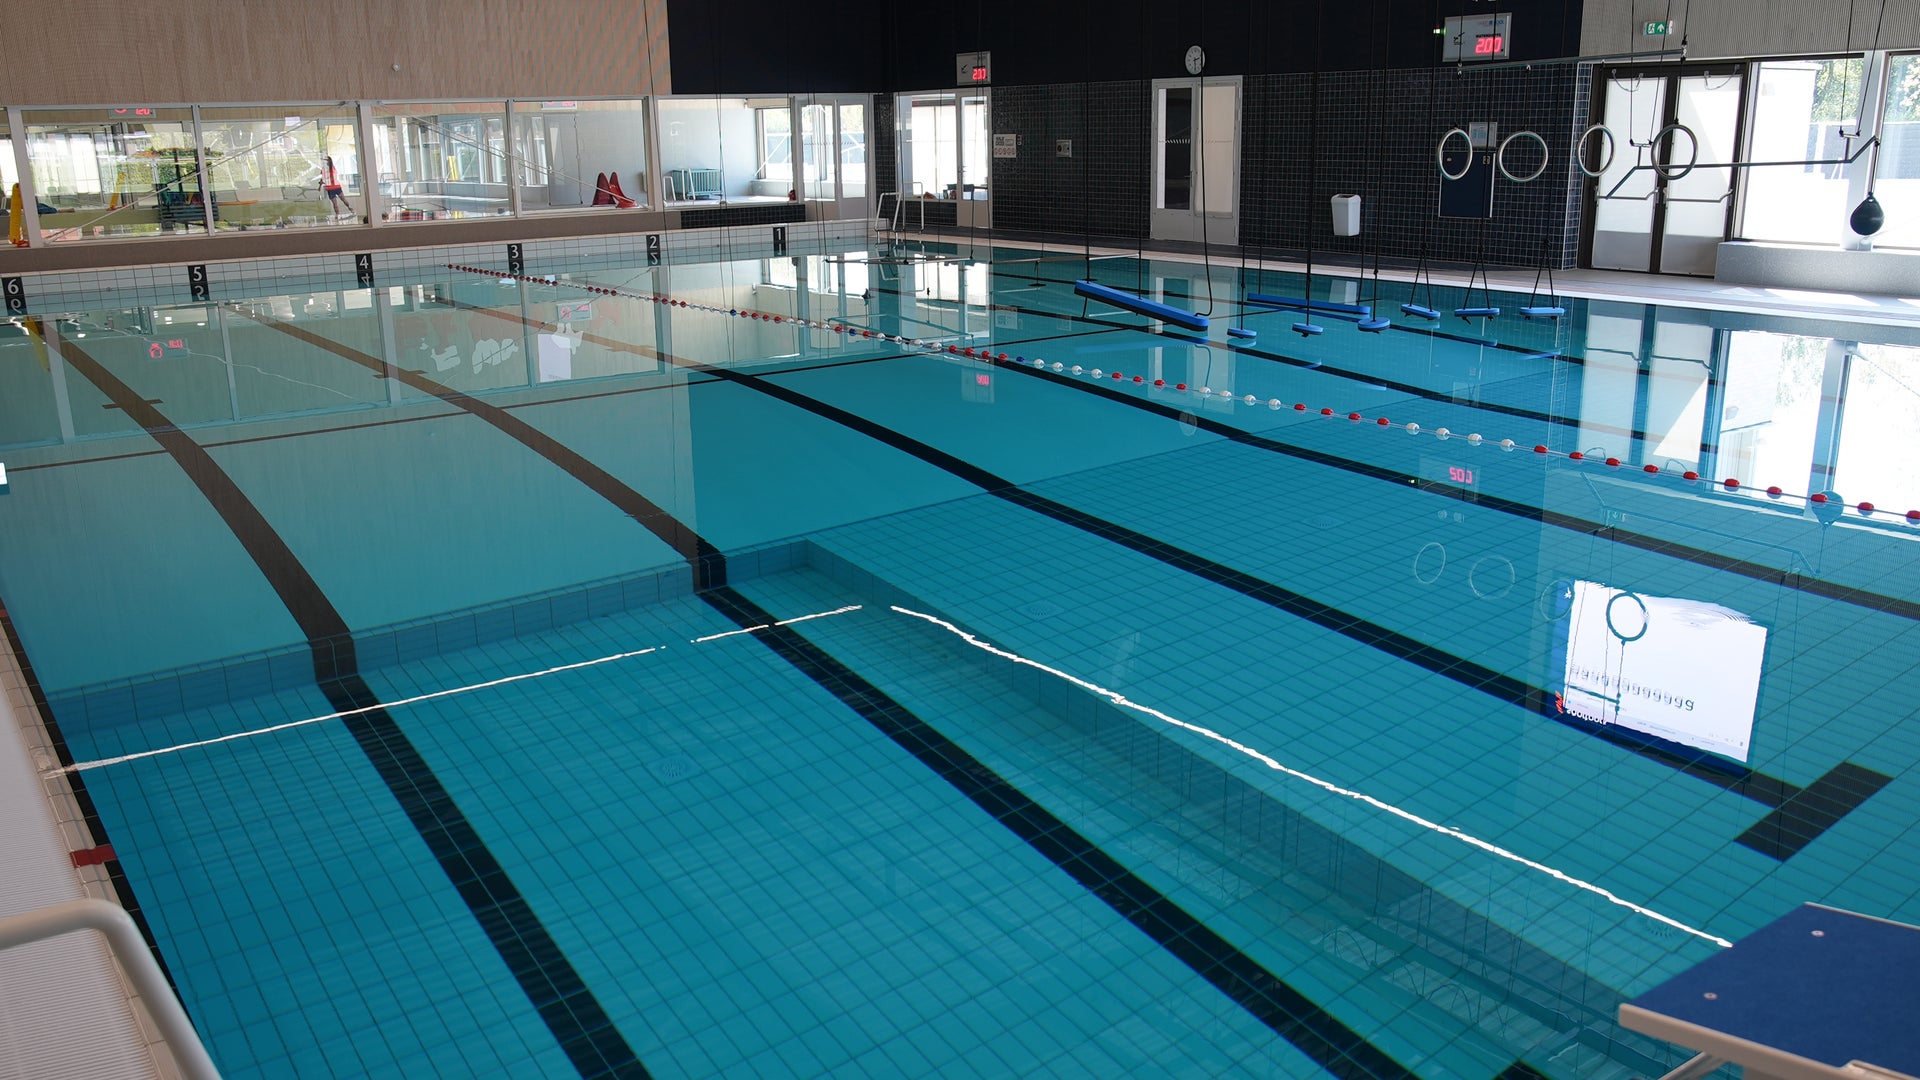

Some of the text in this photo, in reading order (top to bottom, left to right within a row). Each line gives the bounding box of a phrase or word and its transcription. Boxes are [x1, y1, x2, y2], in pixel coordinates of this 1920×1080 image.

[649, 235, 658, 249] 2
[776, 228, 782, 241] 1
[510, 244, 520, 259] 3
[359, 254, 370, 269] 4
[193, 266, 203, 282] 5
[7, 278, 20, 295] 6
